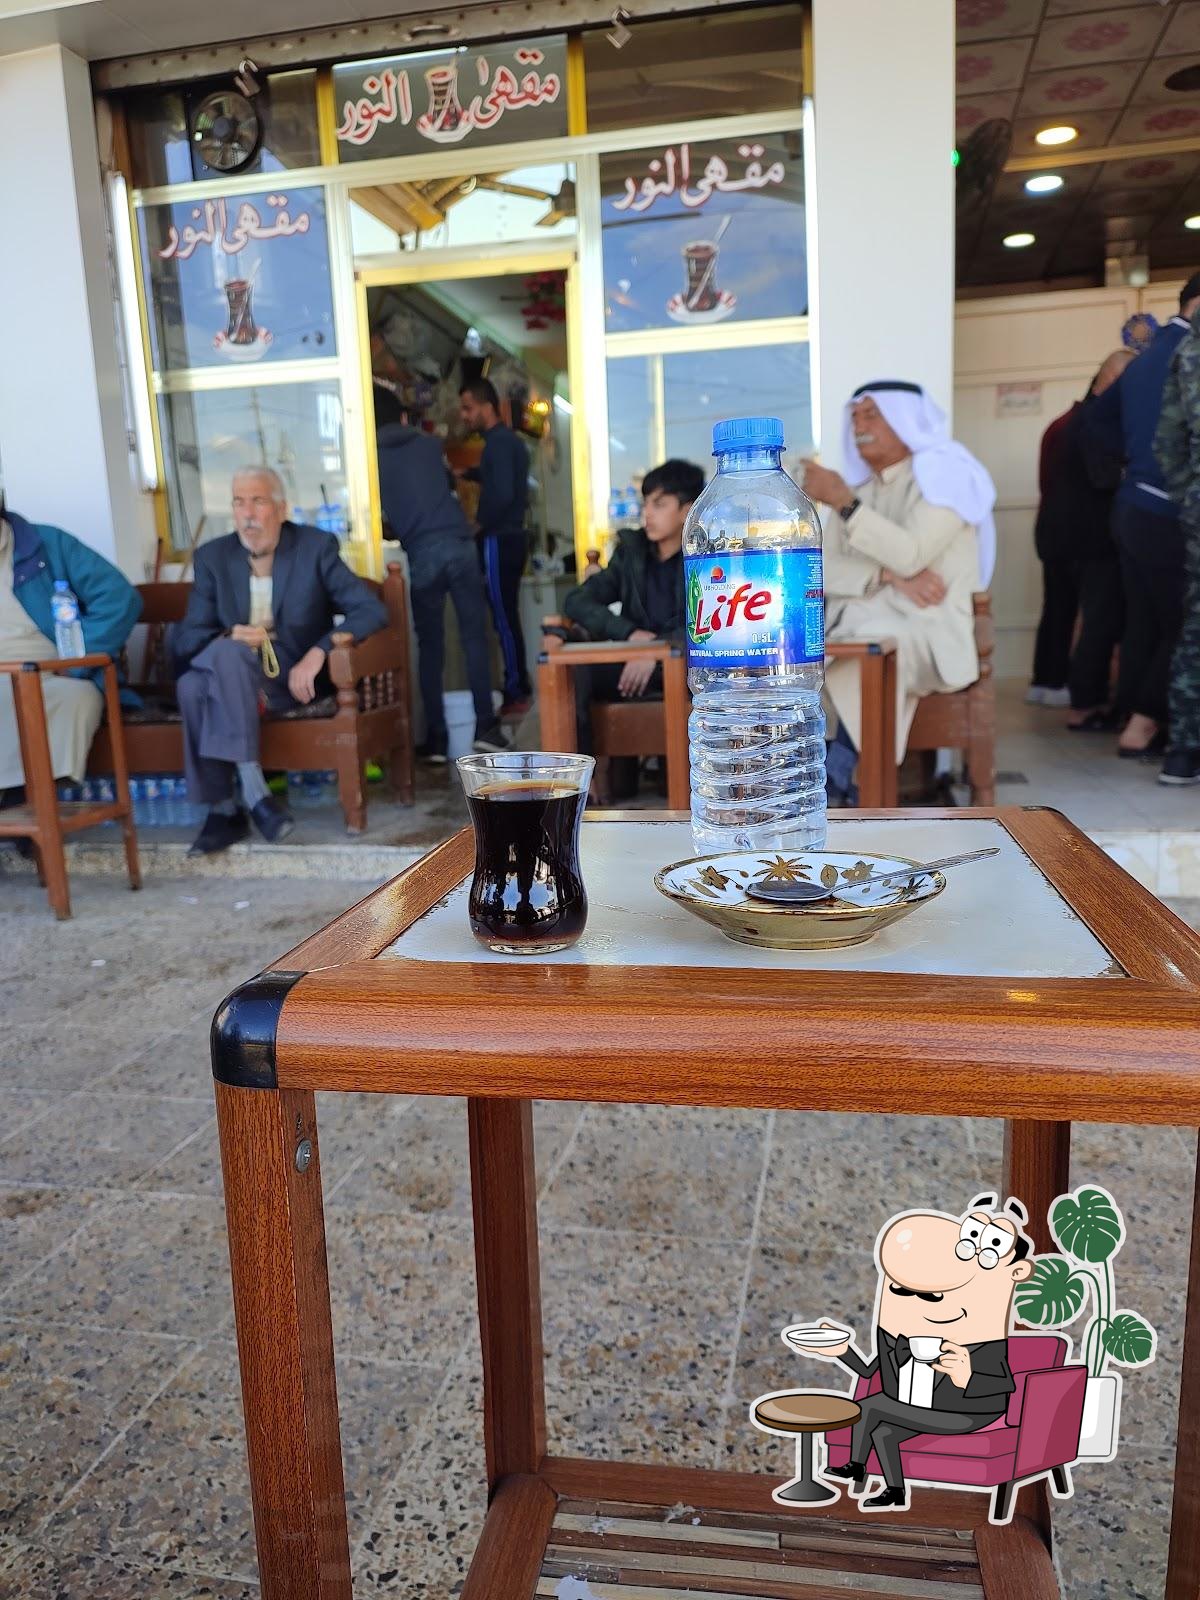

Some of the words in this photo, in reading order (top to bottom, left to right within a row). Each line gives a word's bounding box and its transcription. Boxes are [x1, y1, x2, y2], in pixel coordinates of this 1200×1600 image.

[336, 67, 413, 145] النور
[611, 142, 690, 212] النور
[680, 143, 785, 208] مقهى
[158, 197, 228, 260] النور
[221, 194, 310, 255] مقهى
[695, 583, 772, 635] Life
[714, 649, 744, 657] SPRING
[746, 647, 778, 656] WATER
